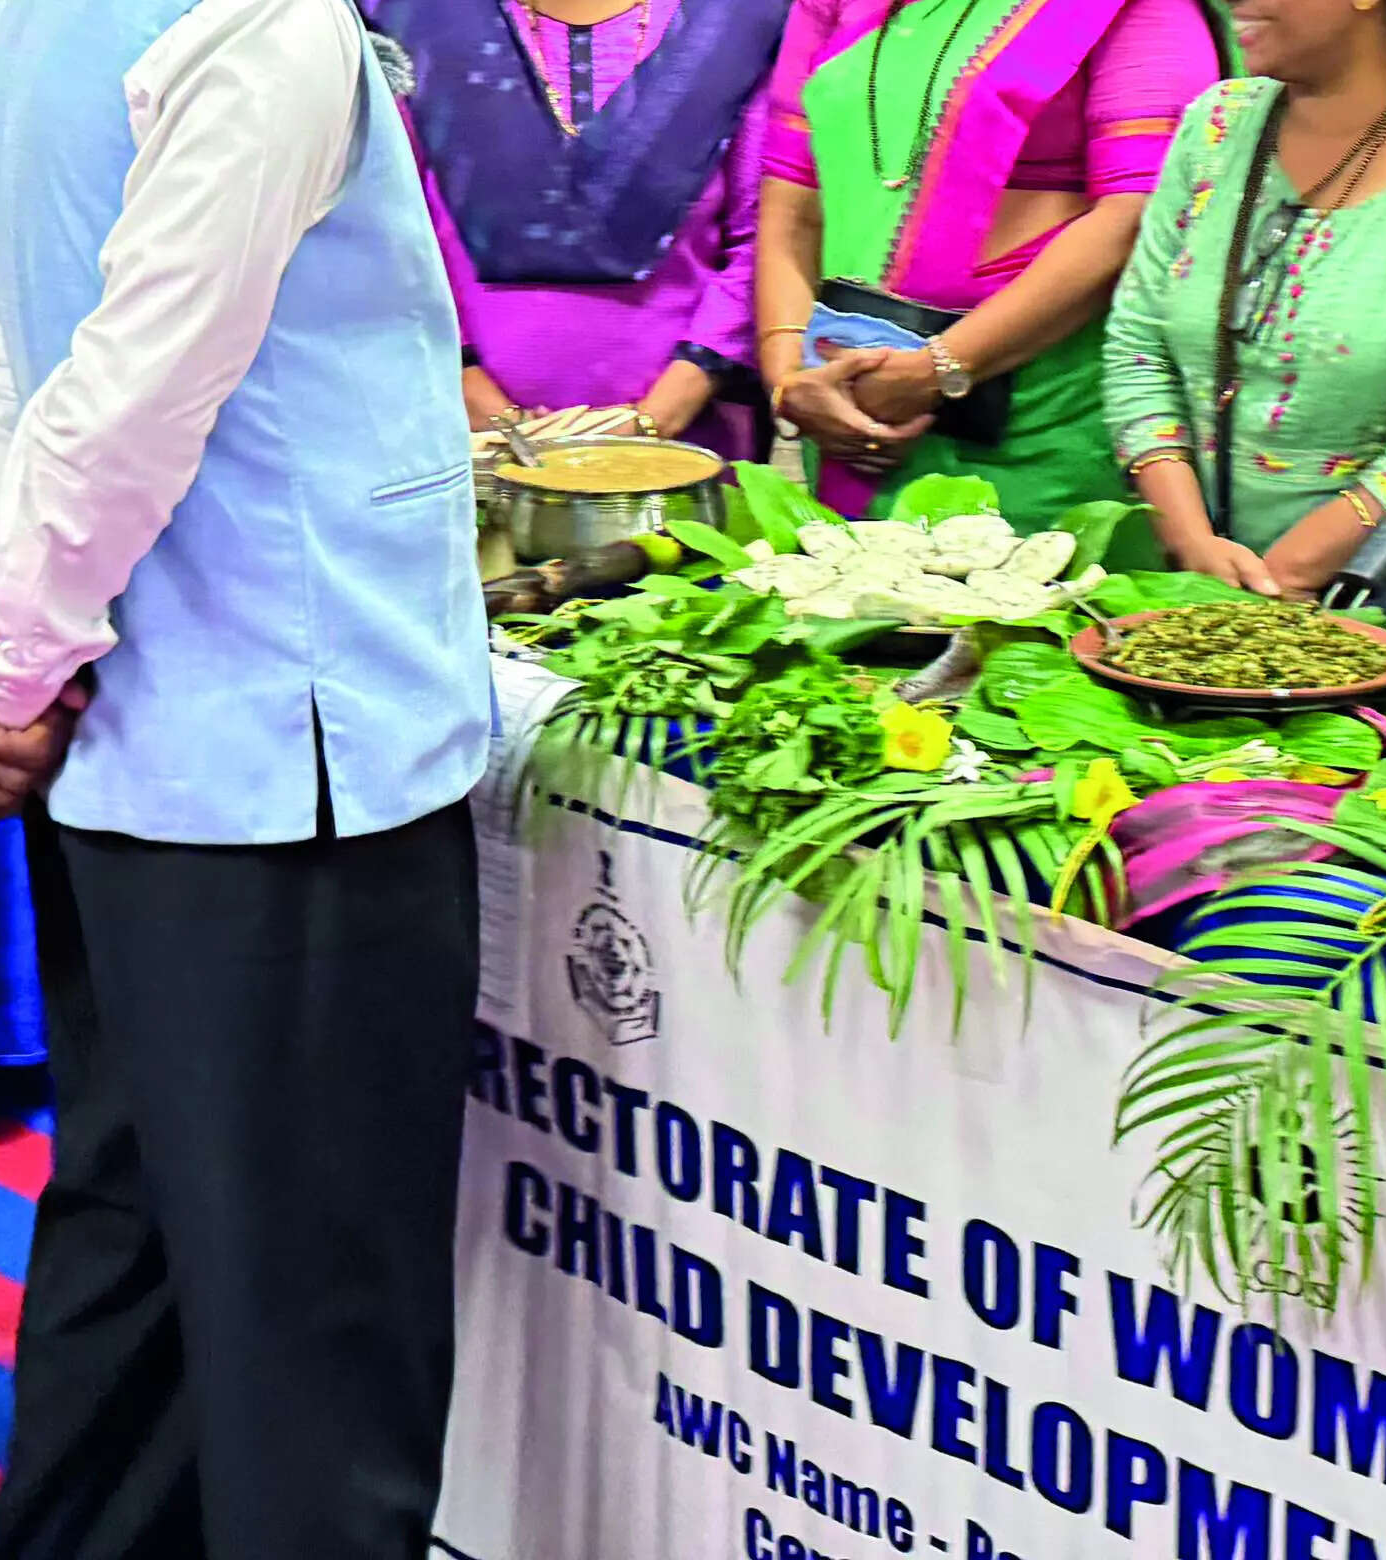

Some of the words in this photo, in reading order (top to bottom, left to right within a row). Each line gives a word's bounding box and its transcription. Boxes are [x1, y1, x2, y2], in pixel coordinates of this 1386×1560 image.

[504, 1161, 725, 1348] CHILD
[962, 1218, 1080, 1350] OF
[653, 1371, 752, 1474] AWC
[765, 1431, 913, 1553] Name
